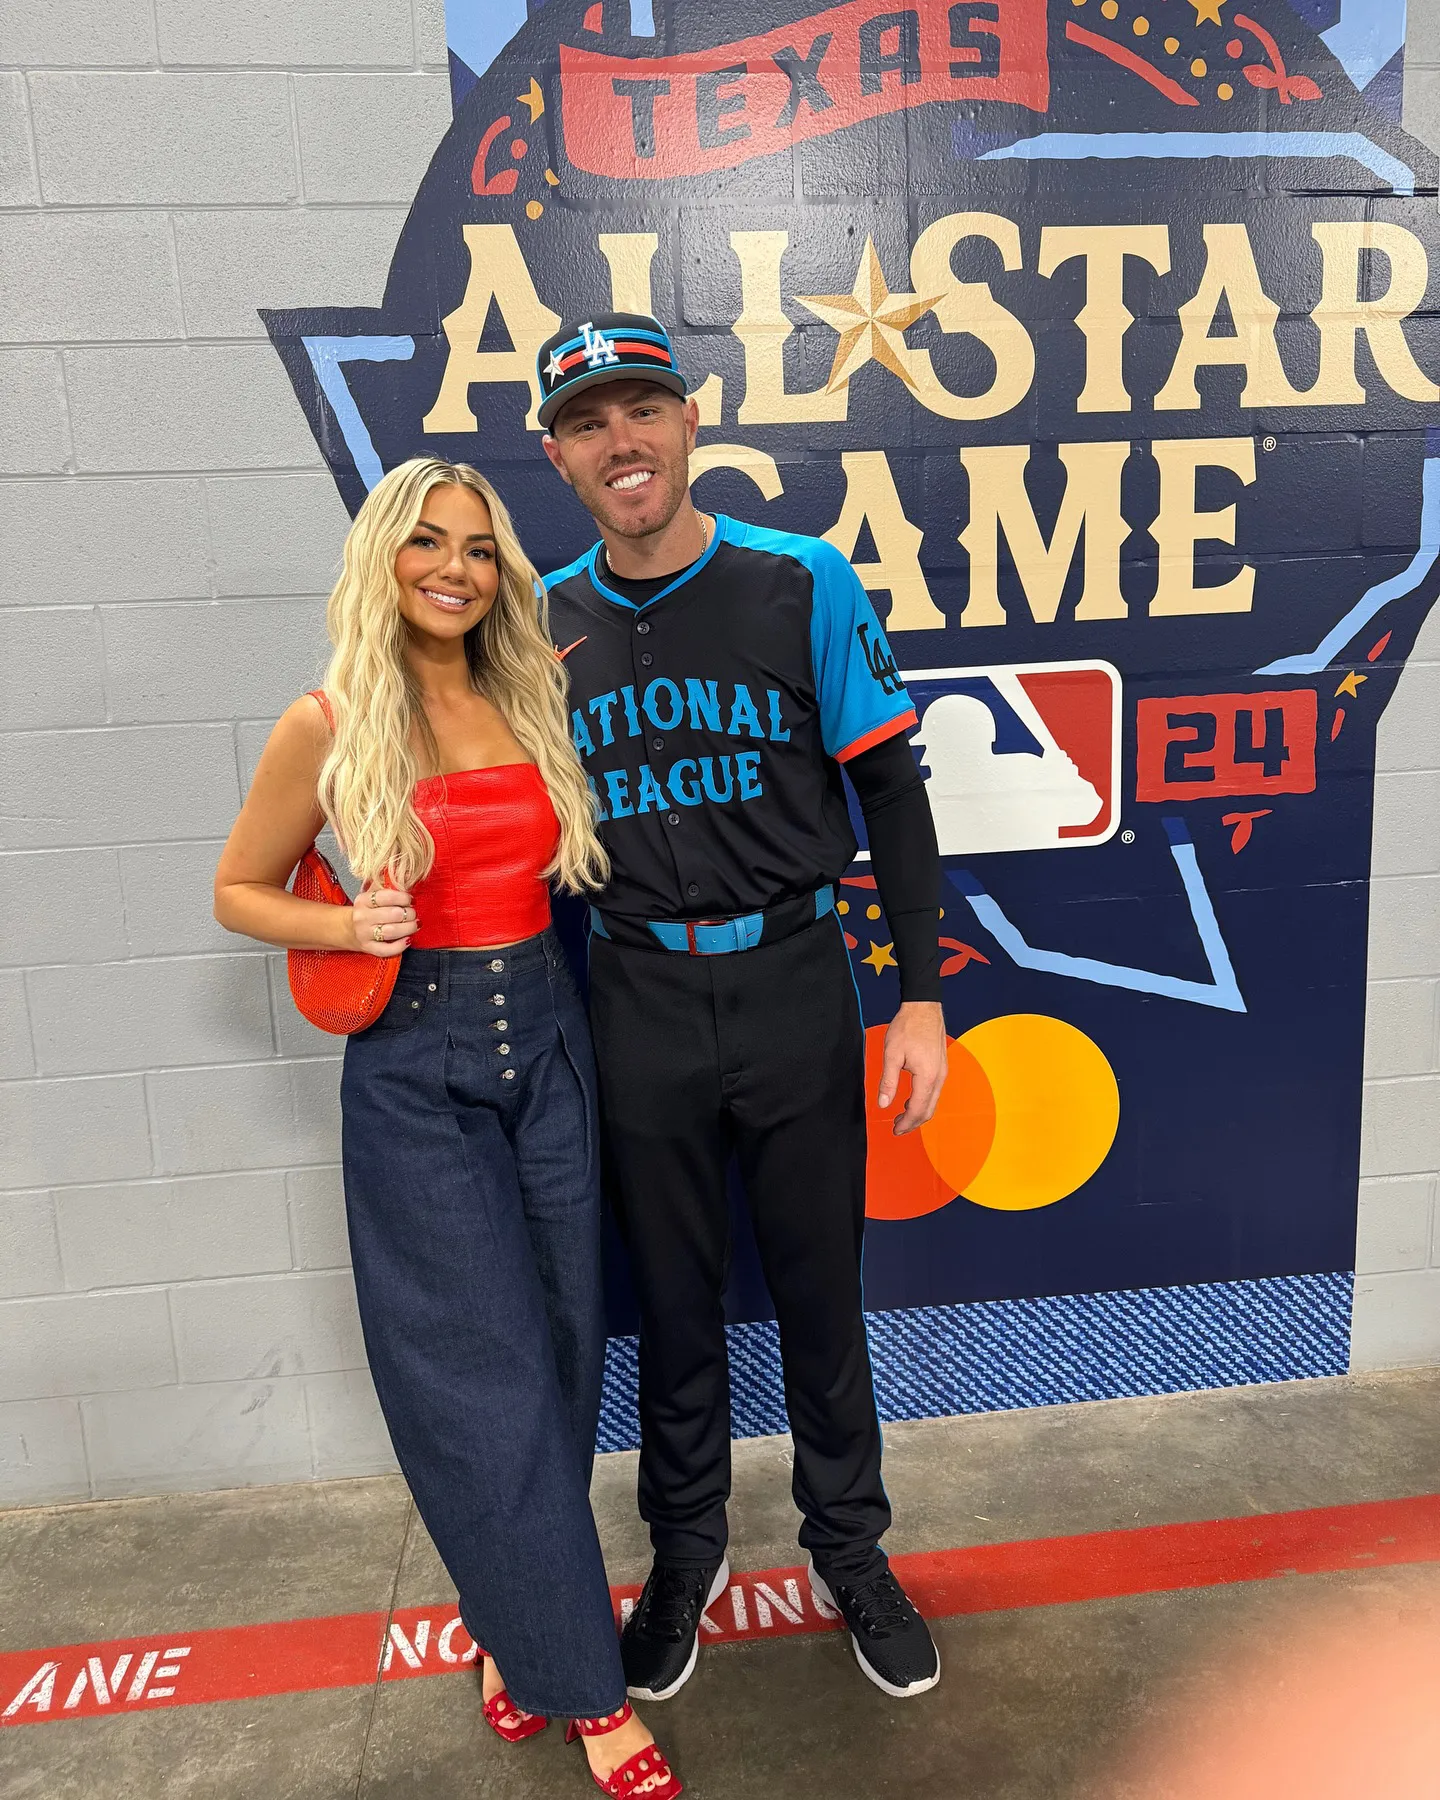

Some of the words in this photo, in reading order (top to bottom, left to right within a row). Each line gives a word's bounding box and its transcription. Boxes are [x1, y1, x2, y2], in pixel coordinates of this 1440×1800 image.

[612, 3, 1000, 158] TEXAS
[578, 322, 620, 369] LA
[857, 622, 906, 696] LA
[571, 677, 791, 762] ATIONAL
[1164, 707, 1290, 784] 24
[1, 1646, 192, 1718] ANE
